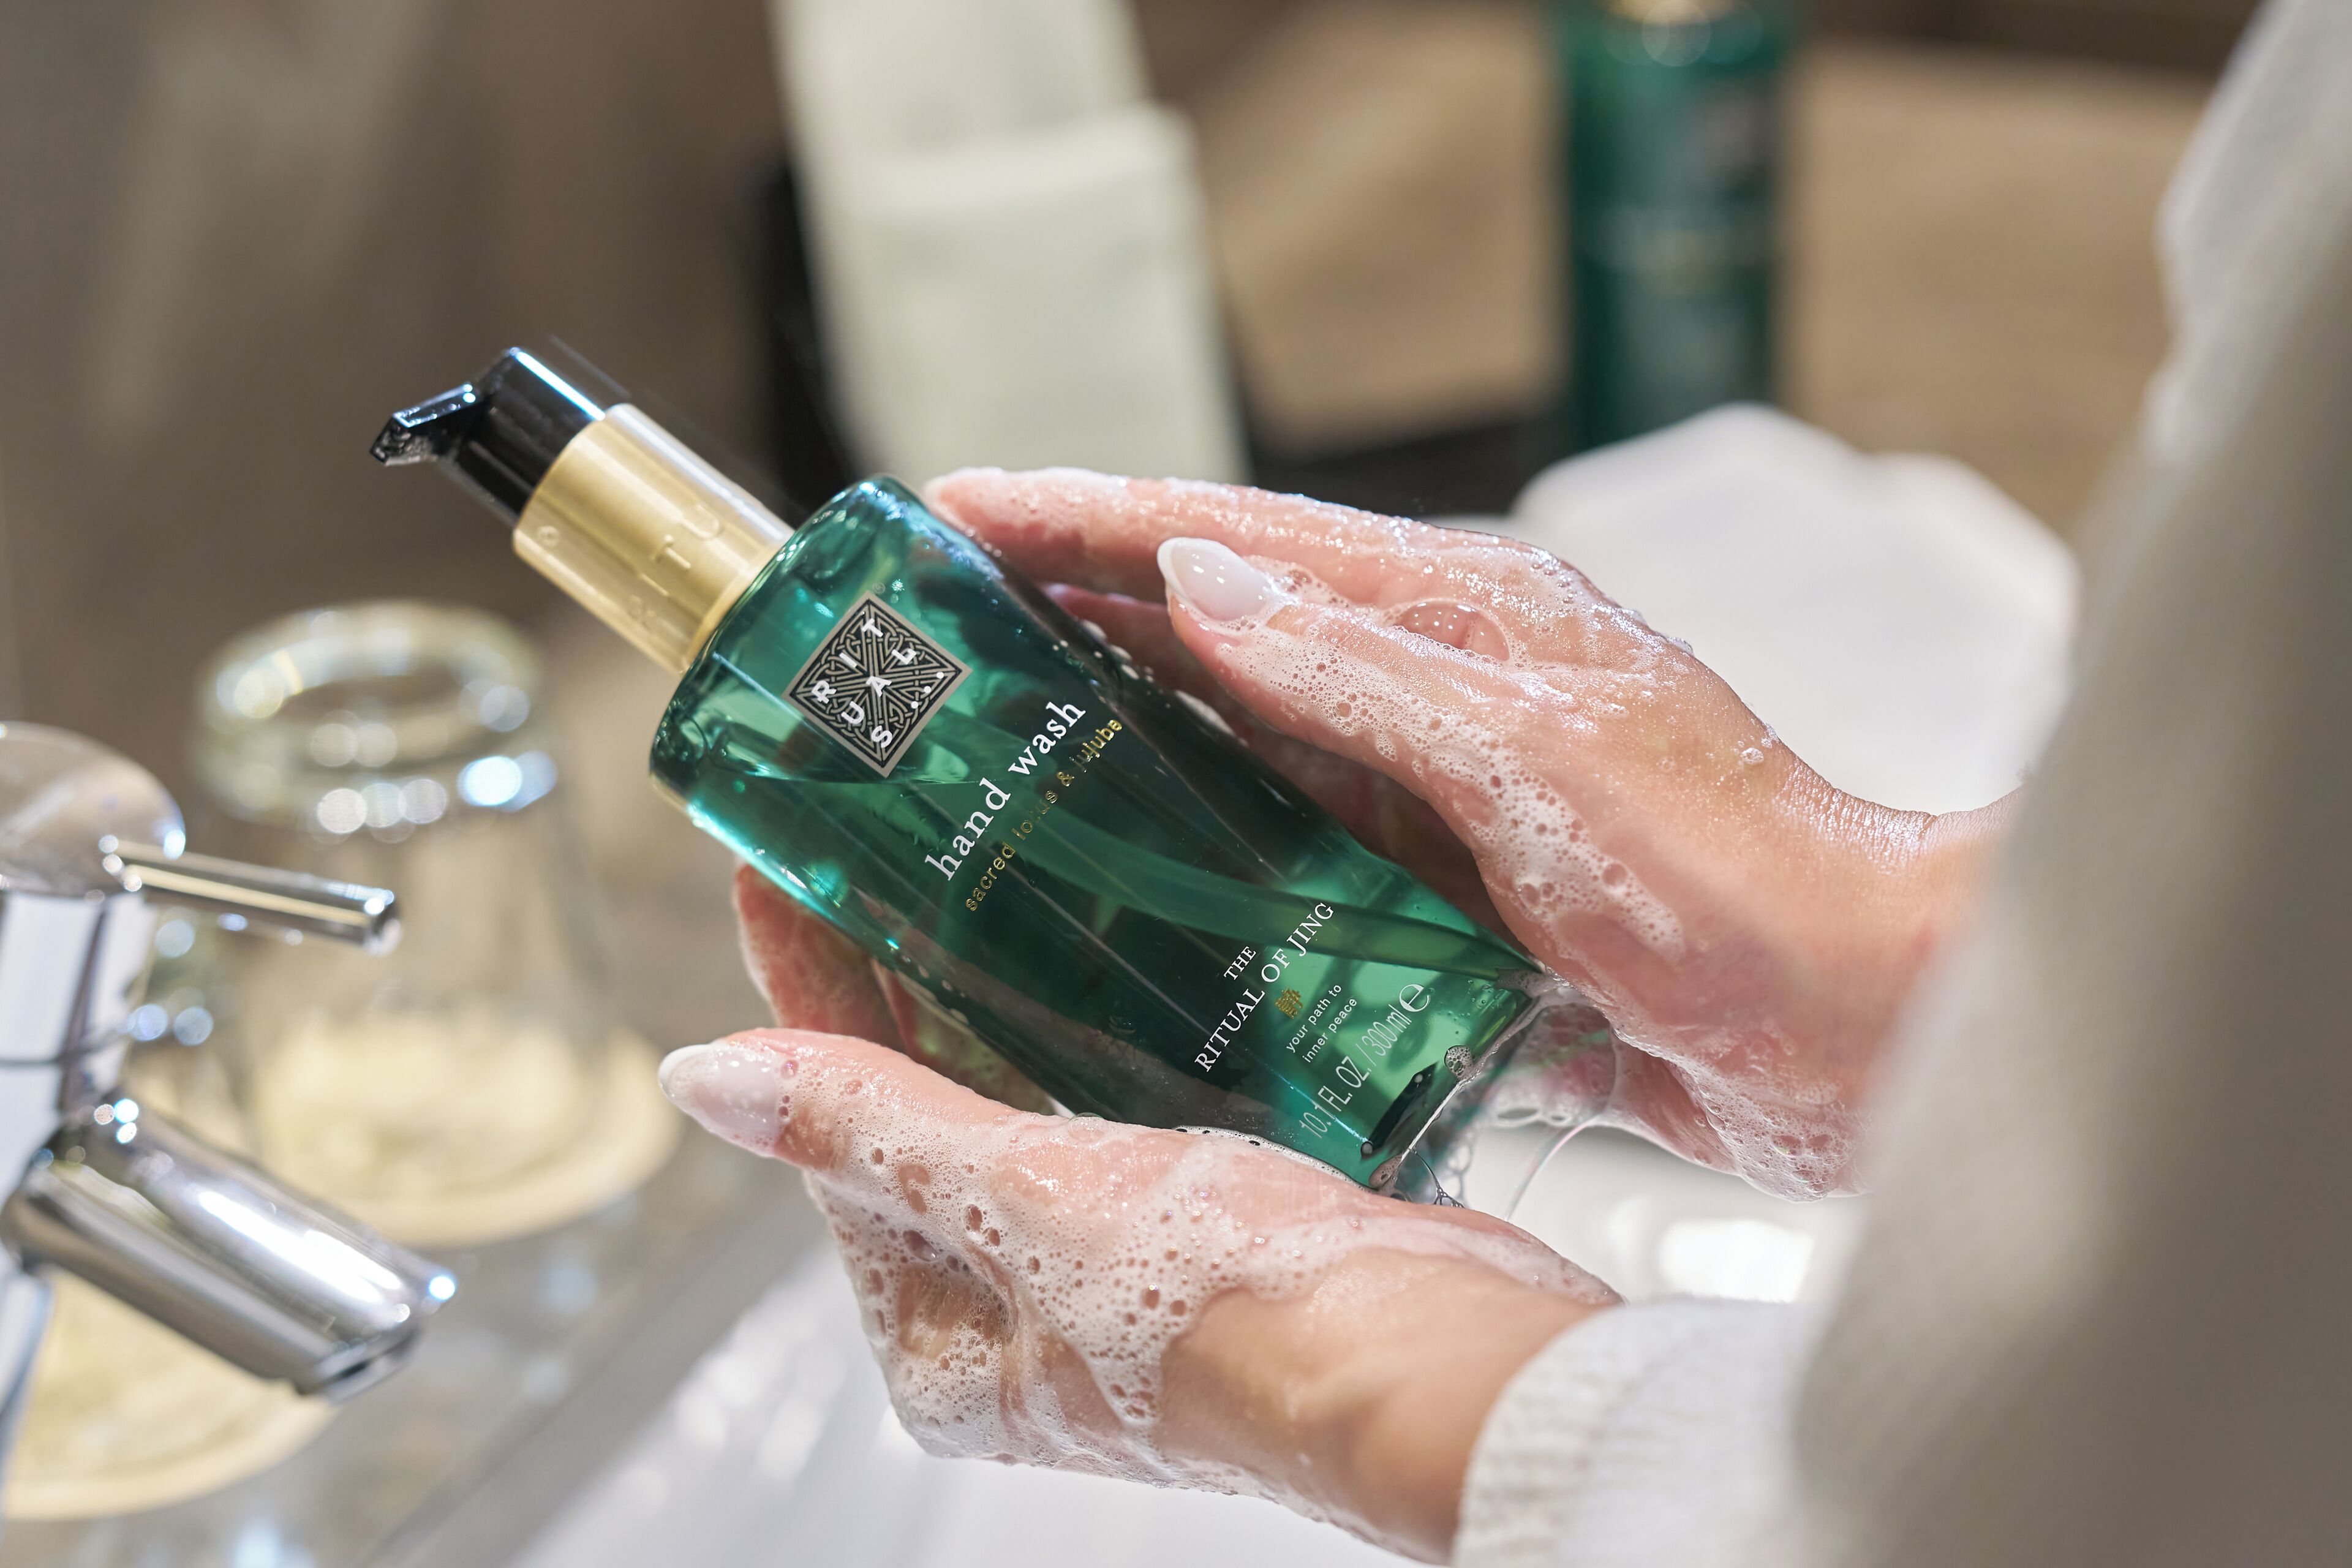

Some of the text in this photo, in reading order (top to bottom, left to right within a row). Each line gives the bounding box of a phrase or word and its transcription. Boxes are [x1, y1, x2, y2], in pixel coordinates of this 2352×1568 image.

[925, 701, 1086, 881] hand wash
[965, 719, 1123, 911] sacred lous & jujube
[1223, 946, 1257, 981] THE
[1194, 902, 1335, 1072] RITUAL OF JING
[1286, 984, 1342, 1053] your path to
[1302, 997, 1357, 1063] inner peace
[1386, 1004, 1412, 1033] ml
[1355, 1043, 1376, 1066] /
[1362, 1022, 1398, 1056] 300
[1335, 1055, 1372, 1088] OZ.
[1317, 1085, 1353, 1112] FL.
[1298, 1102, 1335, 1138] 10.1
